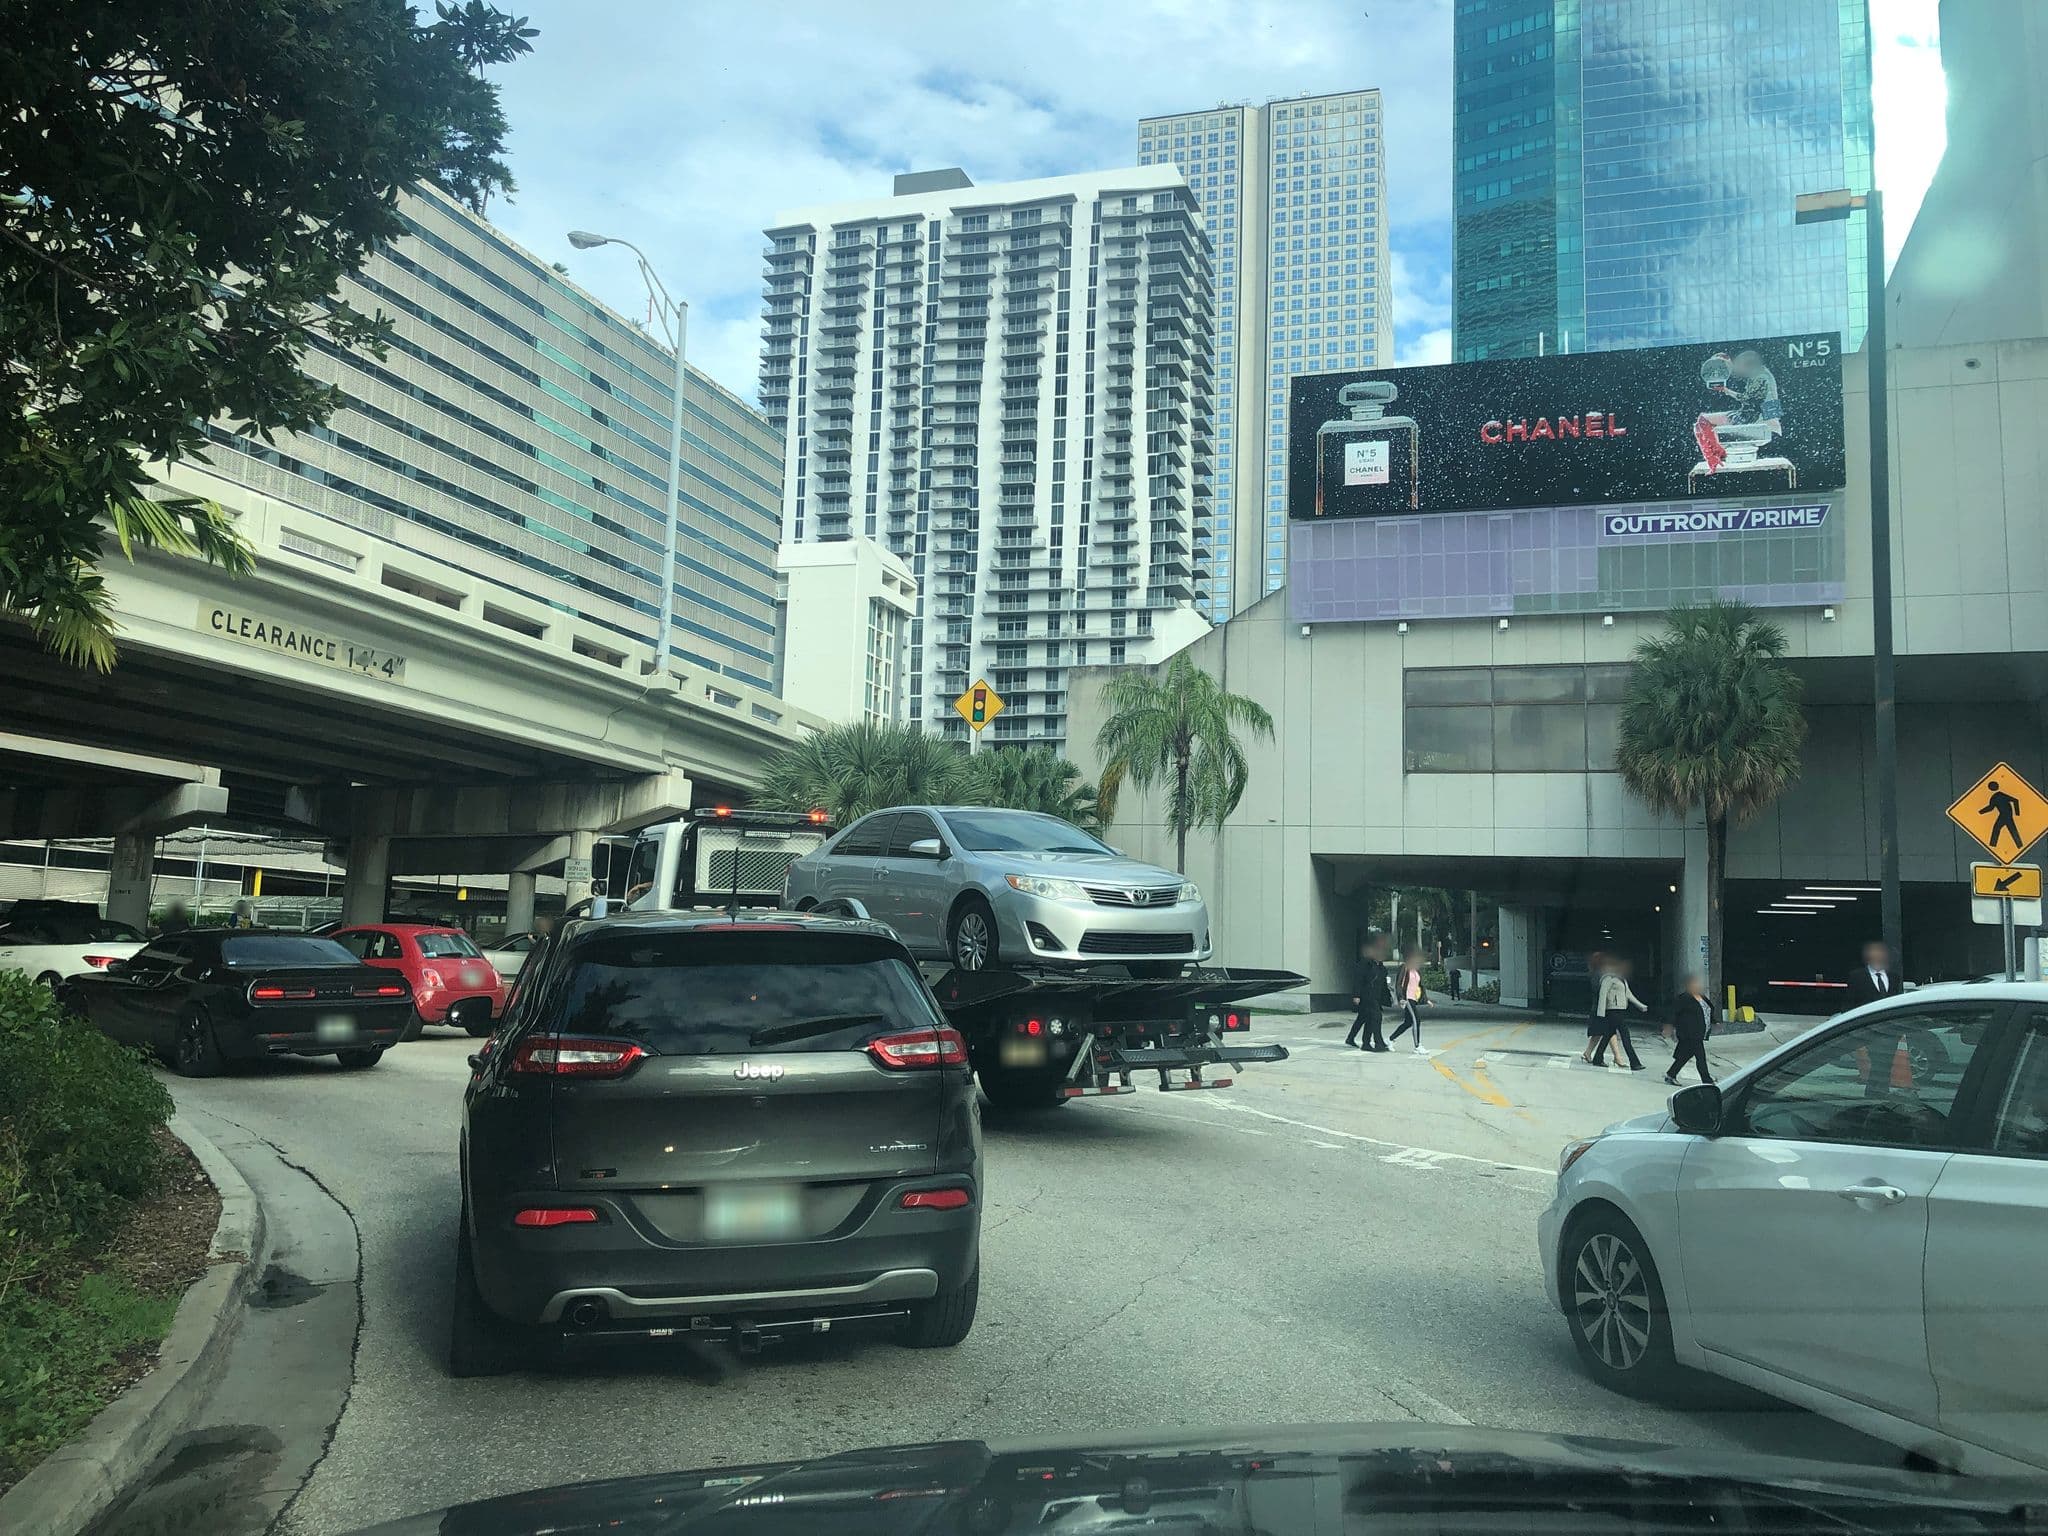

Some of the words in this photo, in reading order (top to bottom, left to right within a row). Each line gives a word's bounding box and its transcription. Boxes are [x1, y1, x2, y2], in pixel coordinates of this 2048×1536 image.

[1793, 359, 1826, 369] L'EAU
[1480, 411, 1628, 444] CHANEL
[1350, 466, 1384, 474] CHANEL
[210, 610, 336, 661] CLEARANCE
[734, 1062, 784, 1082] Jeep
